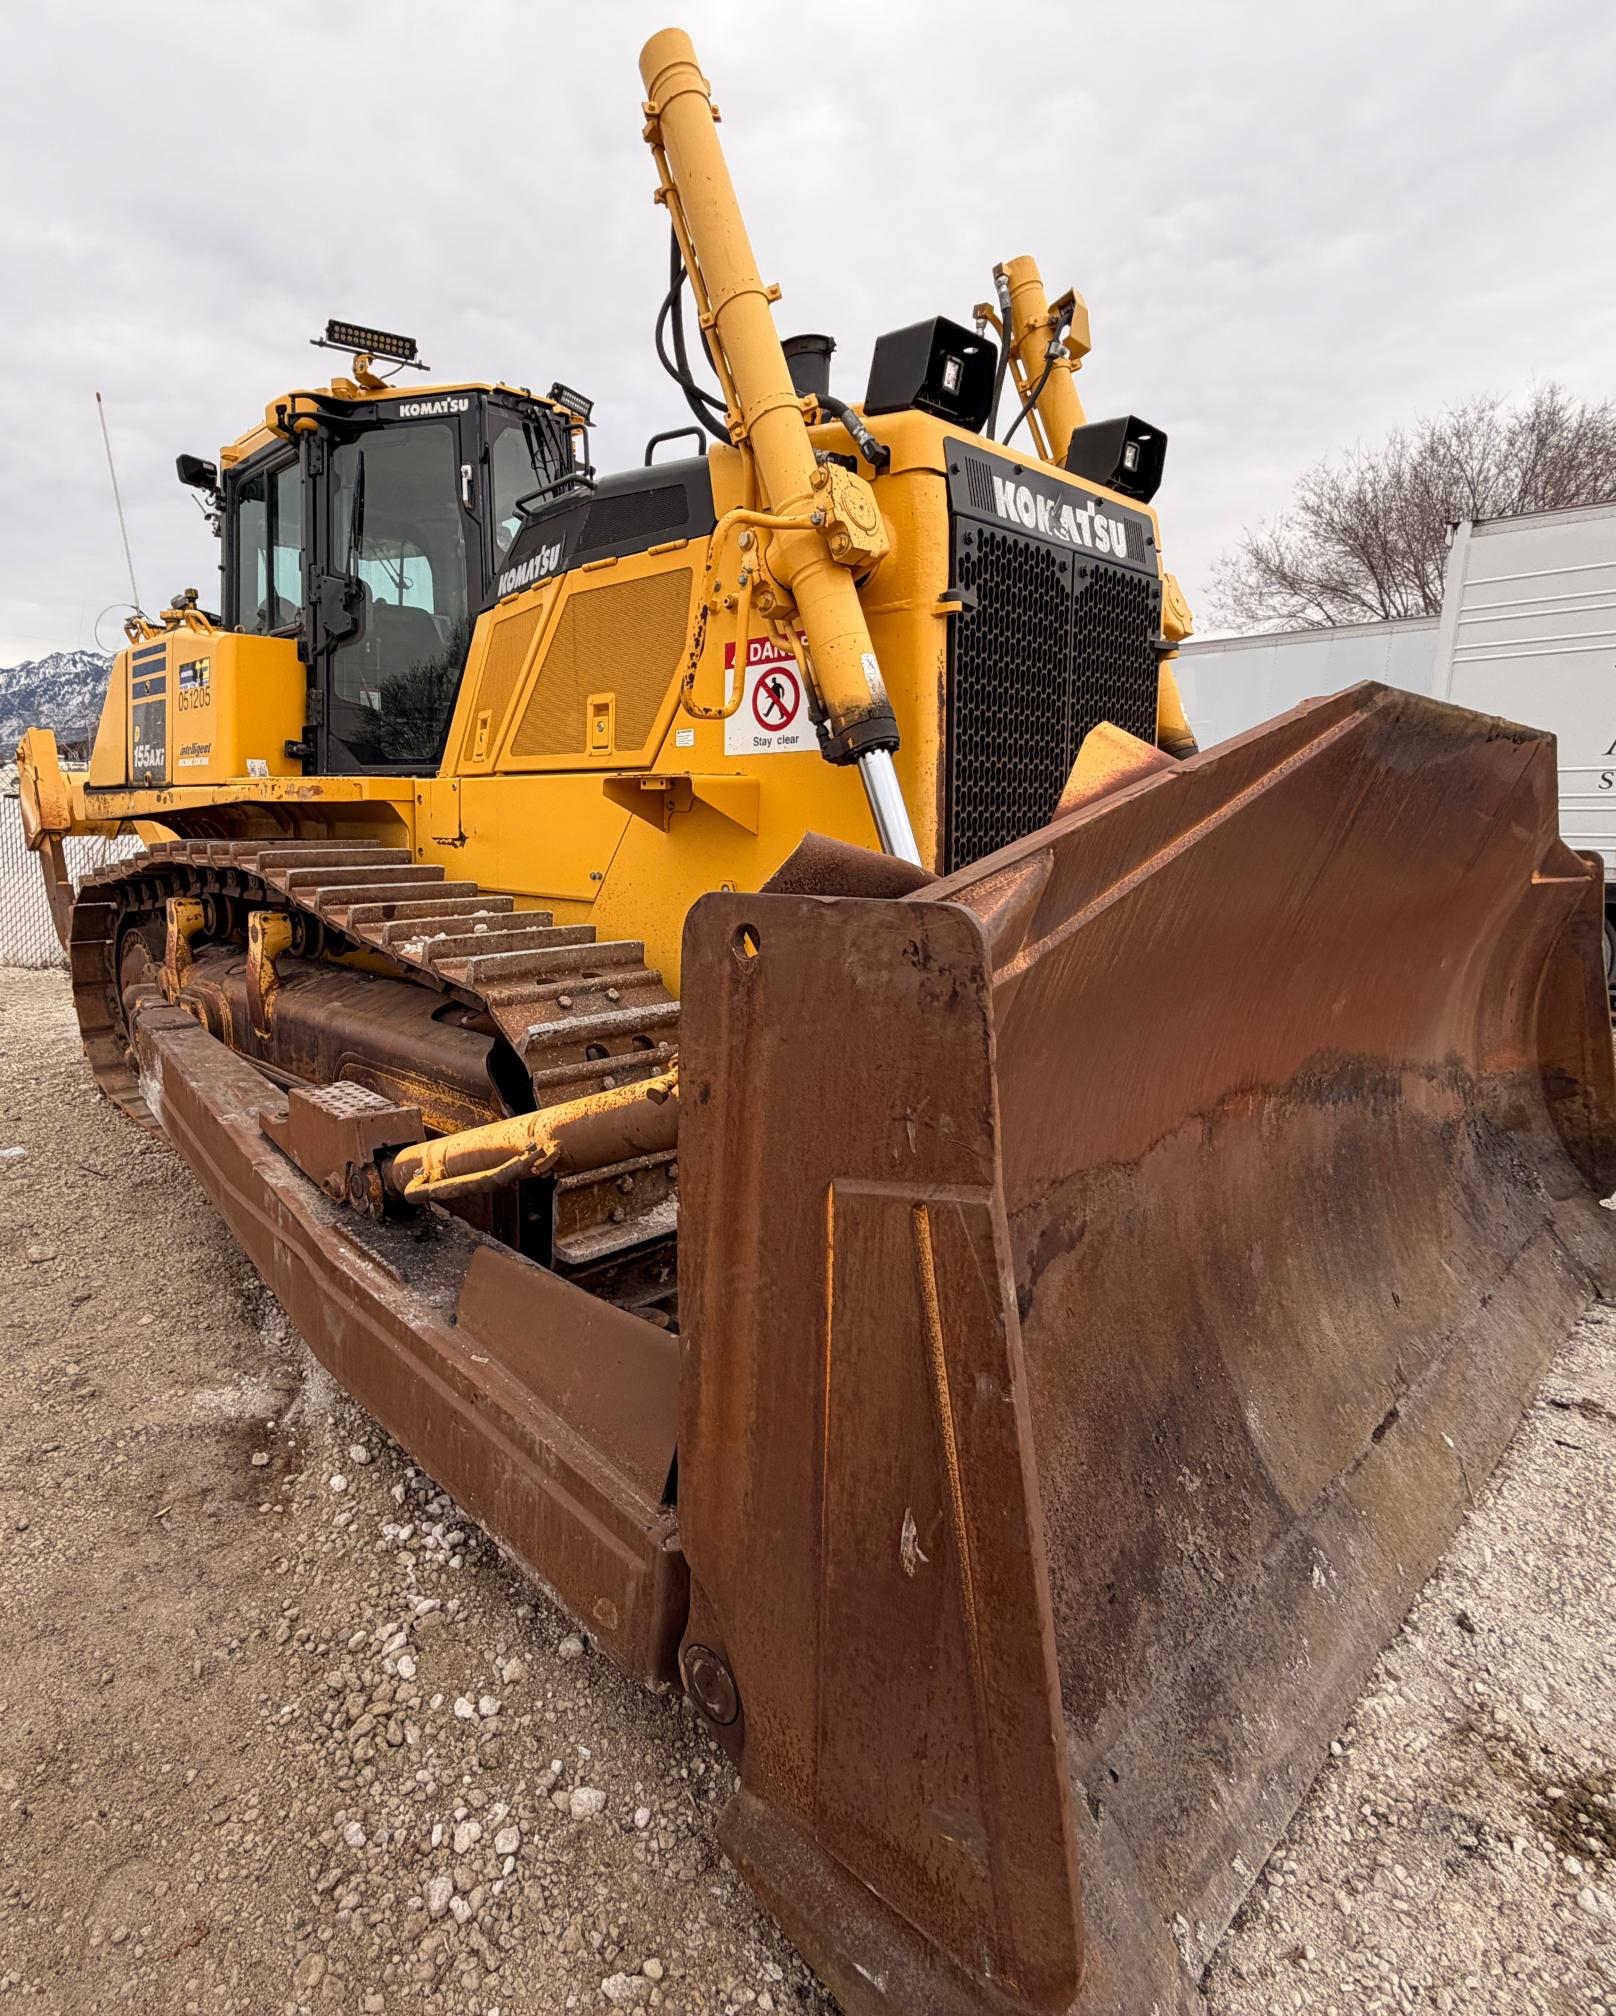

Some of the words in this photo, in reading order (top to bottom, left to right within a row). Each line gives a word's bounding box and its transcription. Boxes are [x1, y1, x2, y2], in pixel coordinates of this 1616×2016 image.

[399, 397, 469, 417] KOMATSU
[497, 543, 561, 597] KOMATSU
[178, 686, 211, 711] 051205
[135, 725, 140, 742] D
[753, 736, 772, 748] Stay
[777, 735, 799, 745] clear
[134, 744, 165, 767] 155AXi
[179, 742, 212, 757] intelligent
